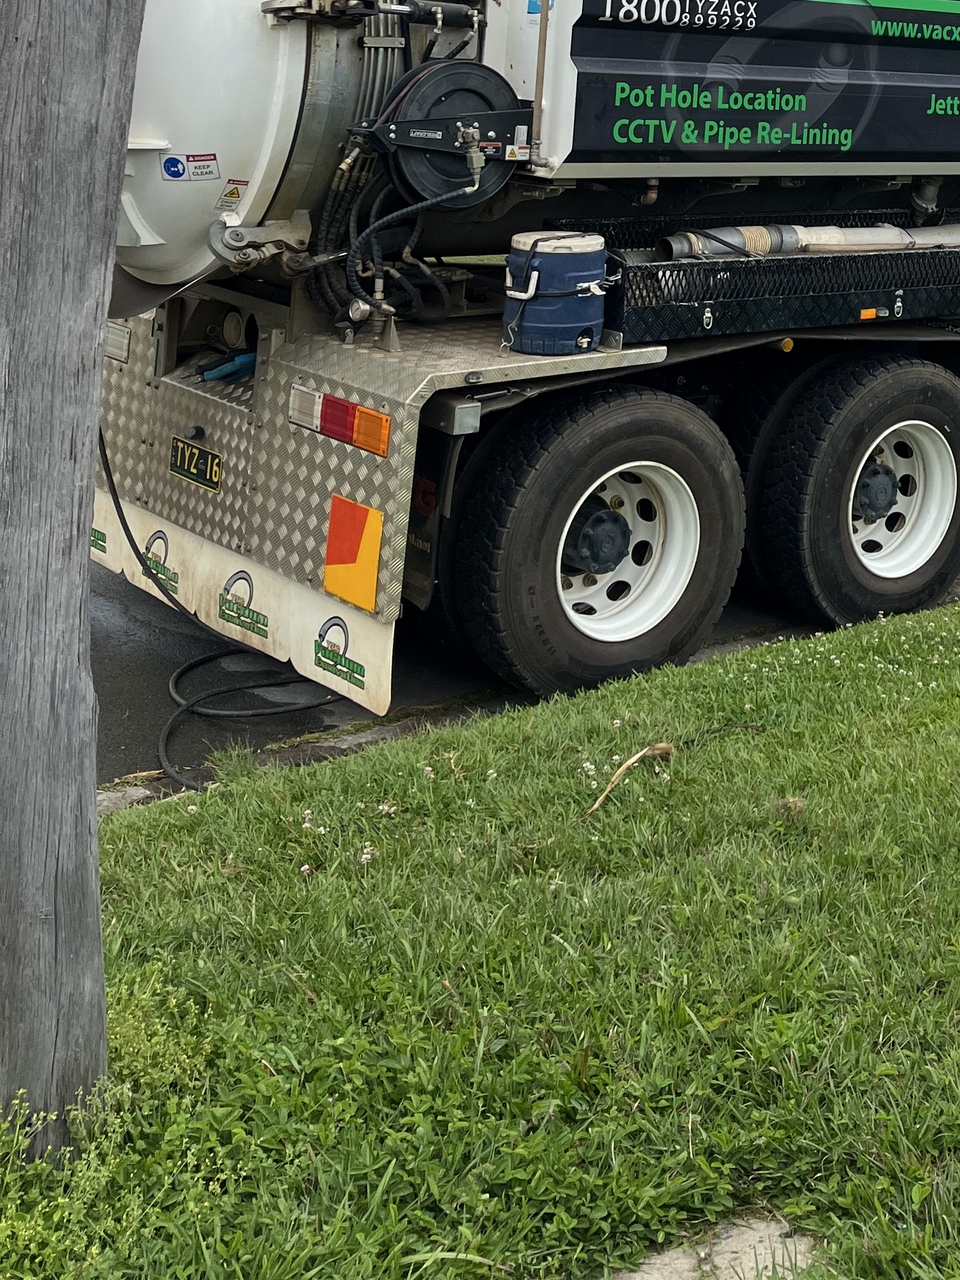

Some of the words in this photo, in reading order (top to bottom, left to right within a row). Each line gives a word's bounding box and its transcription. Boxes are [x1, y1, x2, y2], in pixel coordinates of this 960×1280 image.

[679, 13, 756, 31] 899229
[614, 82, 654, 108] Pot
[660, 83, 712, 109] Hole
[717, 86, 807, 111] Location
[612, 119, 677, 144] CCTV
[681, 120, 699, 144] &
[703, 120, 752, 150] Pipe
[757, 121, 853, 151] Re-Lining
[176, 441, 199, 474] TYZ
[206, 454, 220, 483] 16
